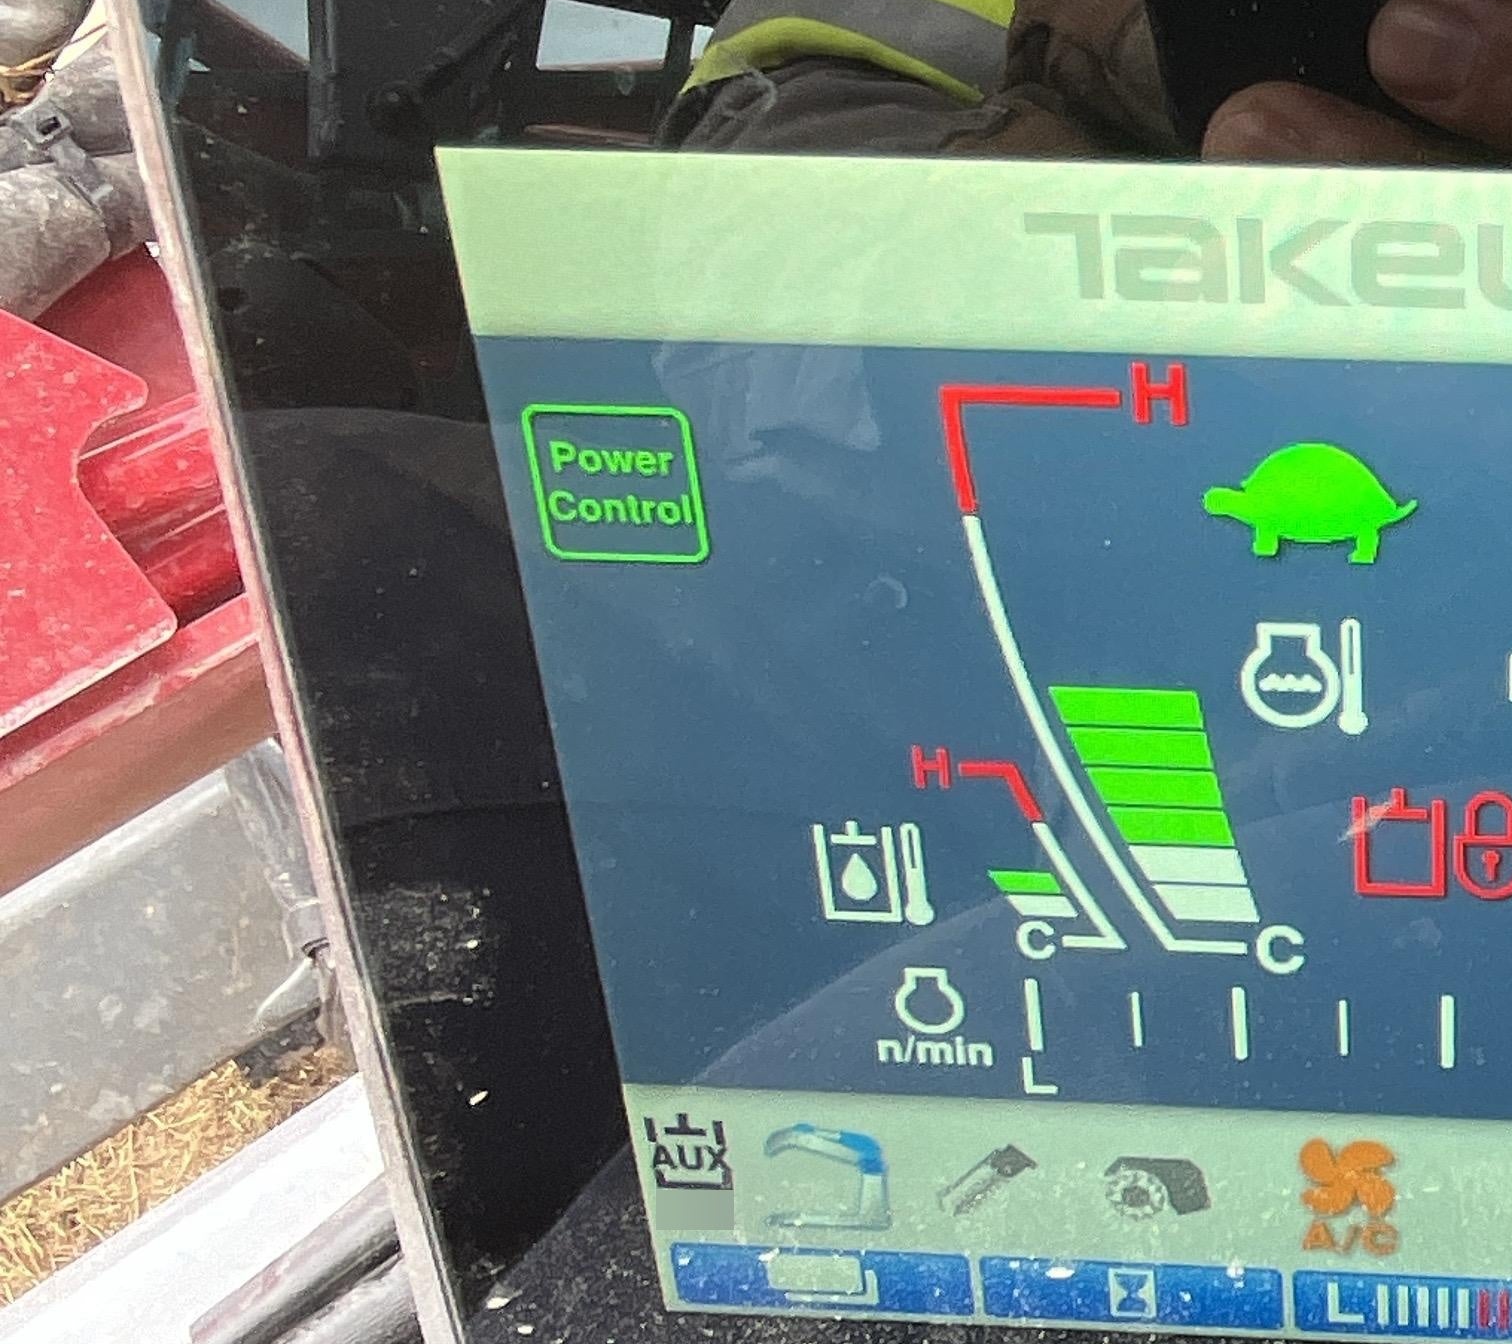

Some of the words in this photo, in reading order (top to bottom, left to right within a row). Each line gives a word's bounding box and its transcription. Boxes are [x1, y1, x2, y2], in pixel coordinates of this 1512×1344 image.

[1130, 360, 1190, 426] H
[548, 438, 675, 478] Power
[547, 488, 693, 528] Control
[911, 744, 951, 790] H
[1014, 919, 1057, 961] C
[1254, 924, 1306, 975] C
[876, 1034, 994, 1068] n/min
[1021, 1055, 1059, 1095] L
[652, 1143, 730, 1172] AUX
[1302, 1220, 1399, 1257] A/C
